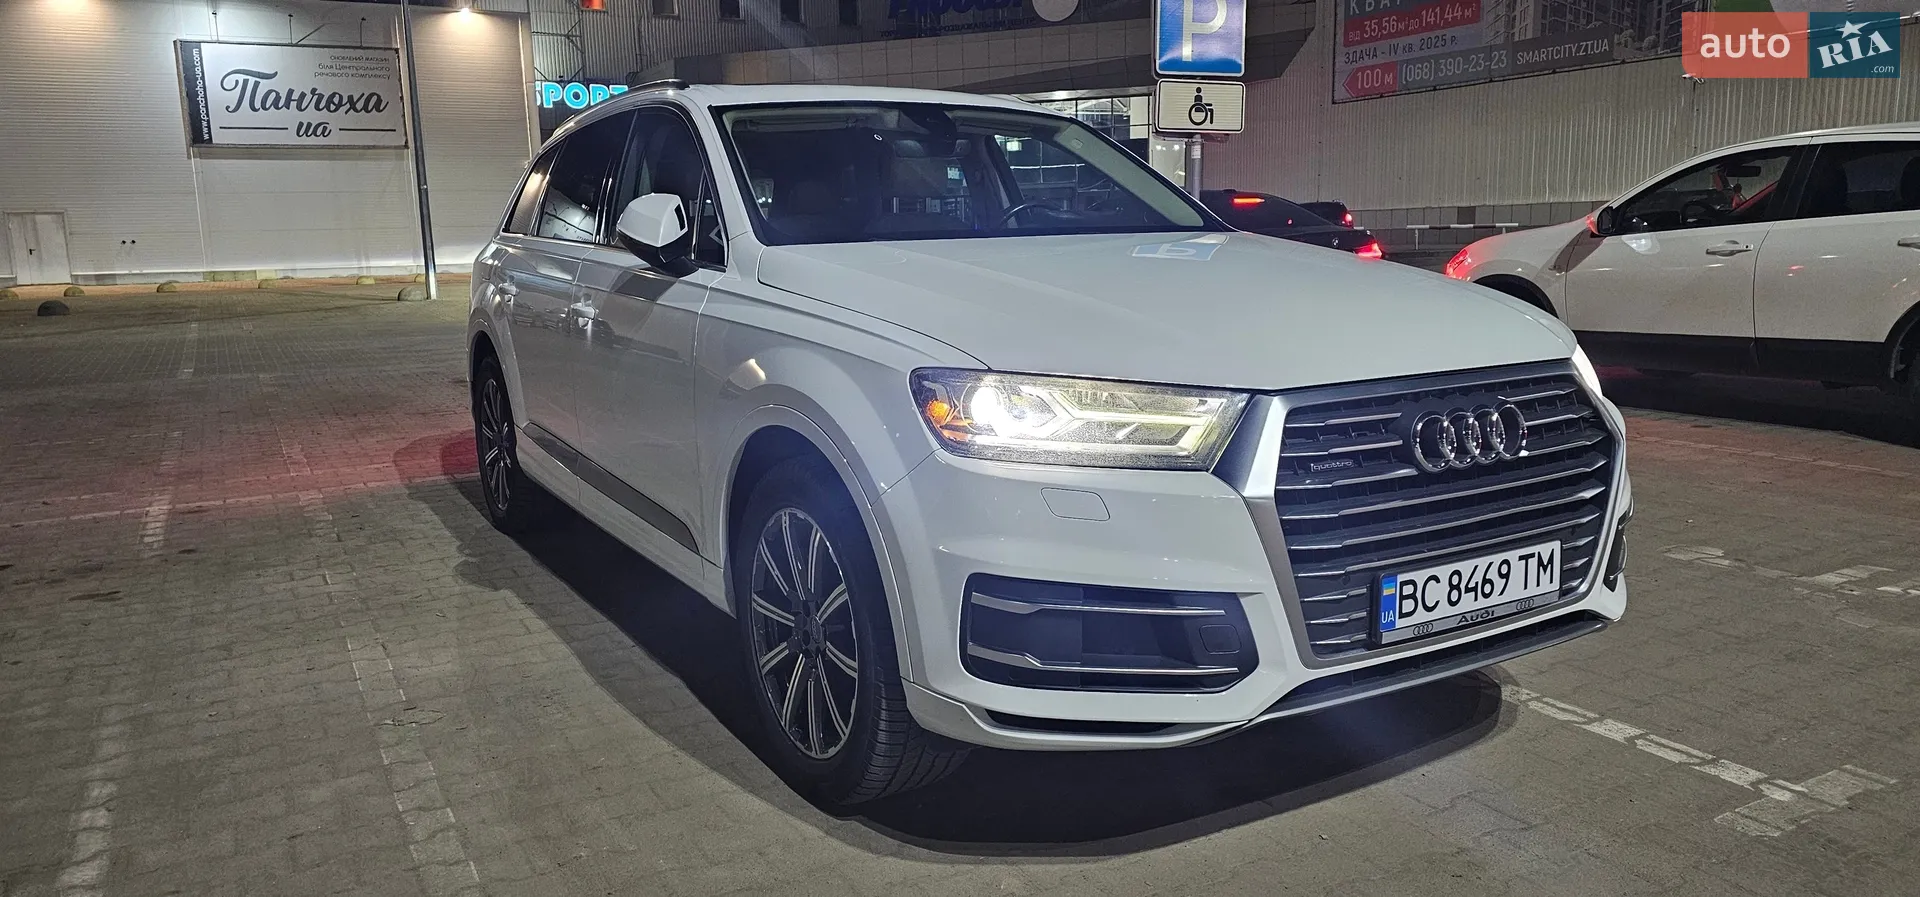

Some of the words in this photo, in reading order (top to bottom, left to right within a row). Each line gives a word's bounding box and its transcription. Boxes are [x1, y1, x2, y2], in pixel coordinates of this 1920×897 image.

[1182, 0, 1227, 61] P
[1344, 46, 1378, 65] ЗДАЧА
[1419, 34, 1447, 51] 2025
[1516, 38, 1609, 65] SMARTCITY.ZT.UA
[318, 62, 334, 70] біля
[1356, 68, 1382, 89] 100
[1402, 59, 1435, 84] (068)
[1438, 50, 1507, 77] 390-23-23
[220, 68, 389, 115] Панчоха
[1398, 574, 1441, 620] BC
[1447, 558, 1512, 608] 8469
[1517, 548, 1556, 590] TM
[1381, 609, 1396, 624] UA
[1456, 608, 1496, 626] Audi
